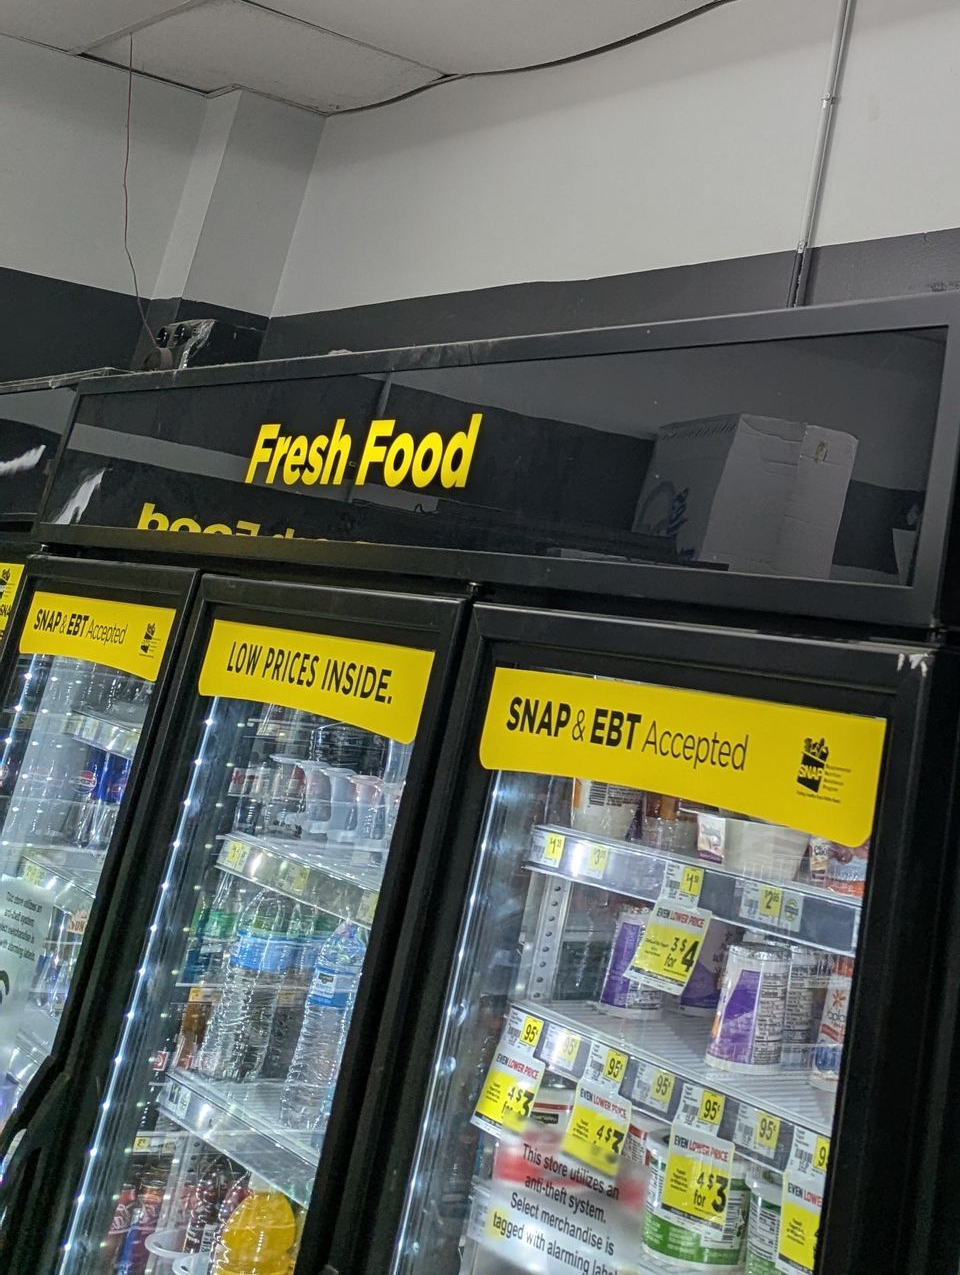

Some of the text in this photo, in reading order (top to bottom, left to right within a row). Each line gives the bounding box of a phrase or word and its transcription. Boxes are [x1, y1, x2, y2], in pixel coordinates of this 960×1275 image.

[245, 413, 483, 489] Fresh Food
[34, 608, 128, 645] SNAP & EBT Accepted
[227, 641, 393, 704] LOW PRICES INSIDE.
[506, 696, 750, 771] SNAP & EBT Accepted
[664, 954, 677, 967] for
[671, 937, 680, 952] 3
[680, 937, 699, 972] $4
[507, 1058, 525, 1073] LOWER
[524, 1066, 539, 1080] PRICE
[508, 1086, 515, 1100] 4
[580, 1088, 593, 1102] EVEN
[593, 1093, 611, 1111] LOWER
[597, 1125, 604, 1140] 4
[674, 1134, 729, 1162] EVEN LOWER PRICE
[522, 1143, 620, 1200] This store utilizes an
[525, 1176, 607, 1223] anti-theft system.
[692, 1189, 706, 1207] for
[696, 1171, 704, 1189] 4
[706, 1174, 728, 1213] $3
[788, 1182, 803, 1199] EVEN
[511, 1192, 615, 1256] Select merchandise is
[493, 1211, 525, 1239] tagged
[525, 1230, 545, 1252] with
[547, 1240, 590, 1275] alarming
